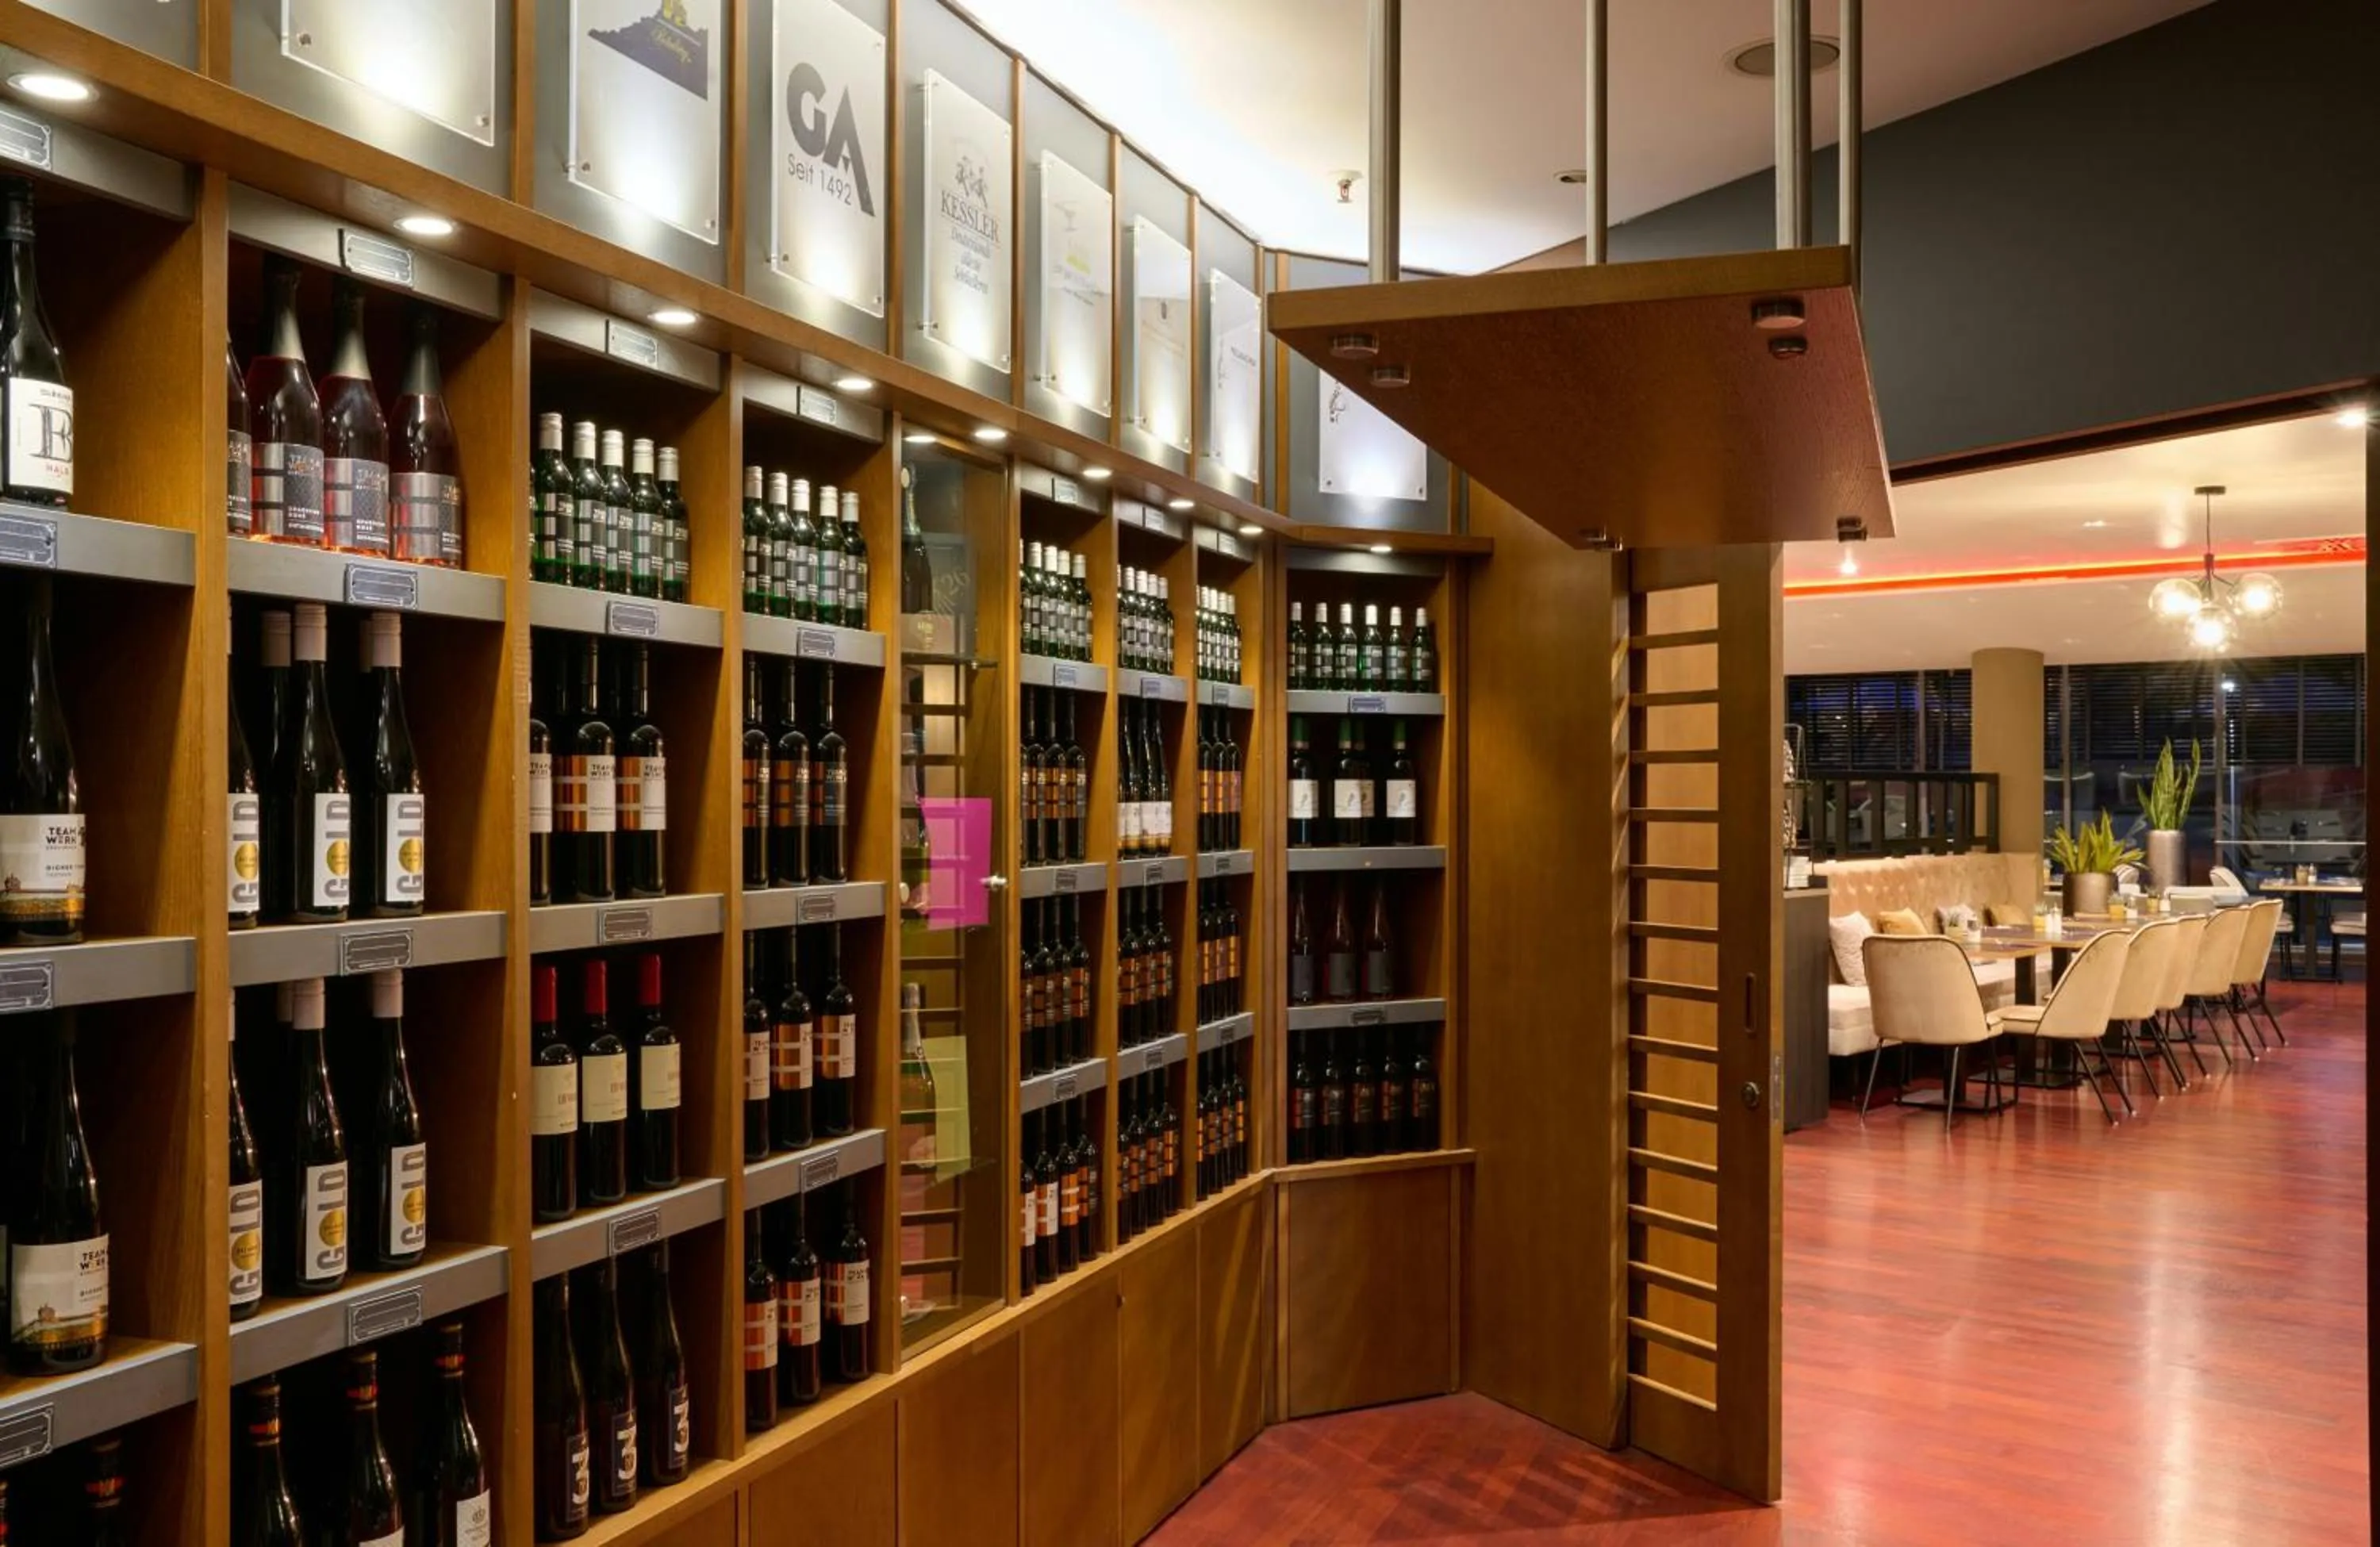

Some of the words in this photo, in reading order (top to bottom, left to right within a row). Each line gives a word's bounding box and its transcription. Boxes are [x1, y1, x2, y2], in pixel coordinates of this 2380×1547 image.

[786, 62, 876, 217] GA
[788, 153, 814, 185] Seit
[820, 169, 852, 205] 1492
[941, 187, 1000, 243] KESSLER
[48, 827, 77, 835] TEAM
[397, 800, 423, 894] GOLD
[317, 1169, 346, 1270] GOLD
[400, 1150, 426, 1246] GOLD
[229, 1190, 261, 1296] GOLD
[572, 1448, 589, 1504] 3
[616, 1426, 637, 1480] 3
